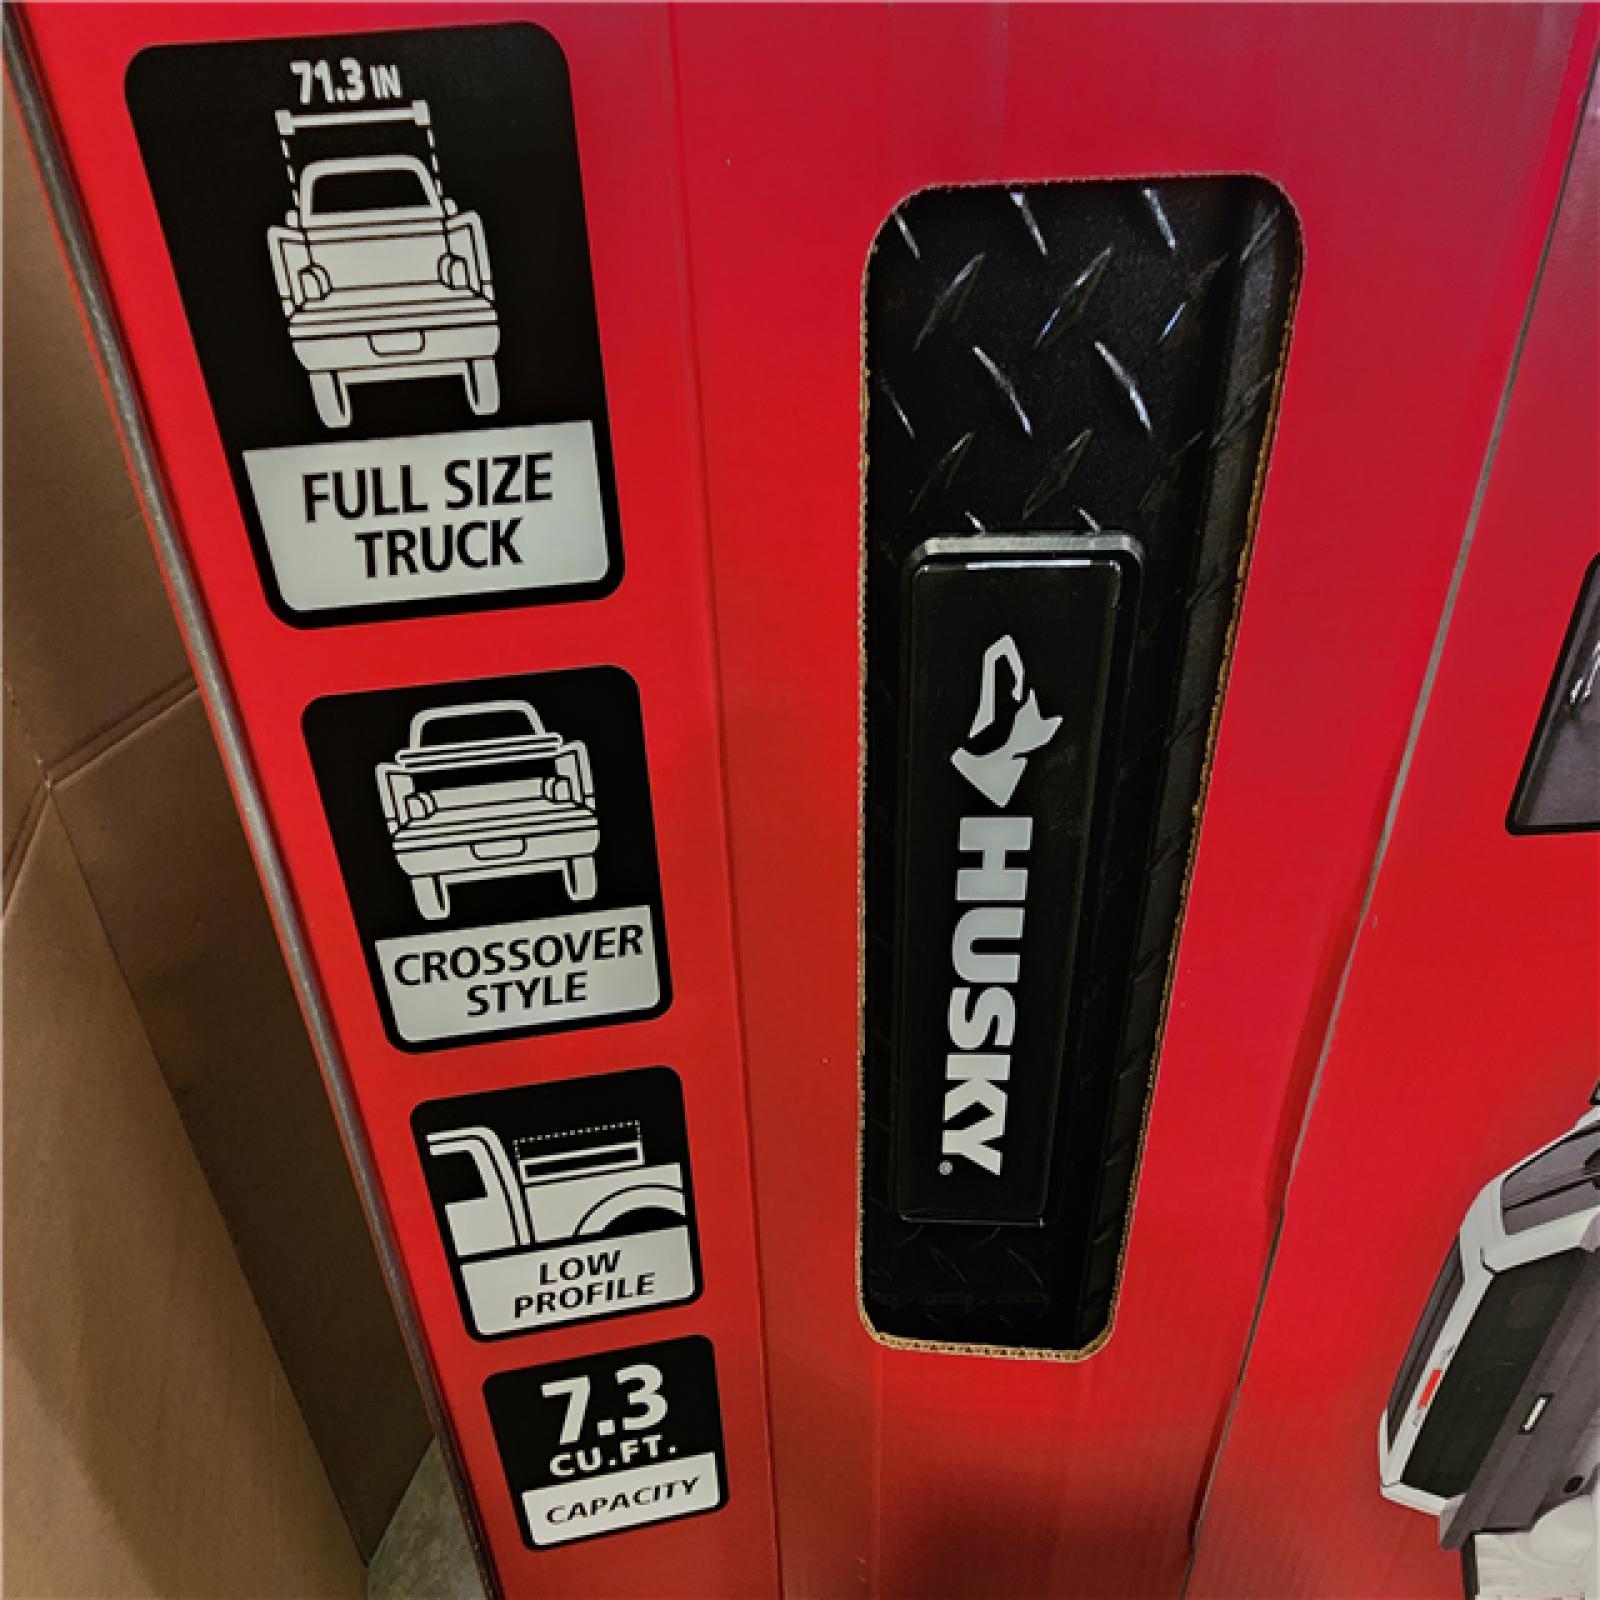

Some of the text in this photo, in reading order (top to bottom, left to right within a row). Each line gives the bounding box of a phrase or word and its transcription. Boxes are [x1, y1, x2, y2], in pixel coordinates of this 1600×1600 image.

[290, 57, 401, 104] 71.3 IN
[302, 452, 553, 523] FULL SIZE
[355, 518, 523, 578] TRUCK
[393, 924, 644, 986] CROSSOVER
[466, 971, 588, 1017] STYLE
[941, 816, 1034, 1176] HUSKY
[514, 1272, 656, 1318] PROFILE
[538, 1249, 622, 1286] LOW
[541, 1363, 669, 1446] 7.3
[546, 1475, 701, 1525] CAPACITY
